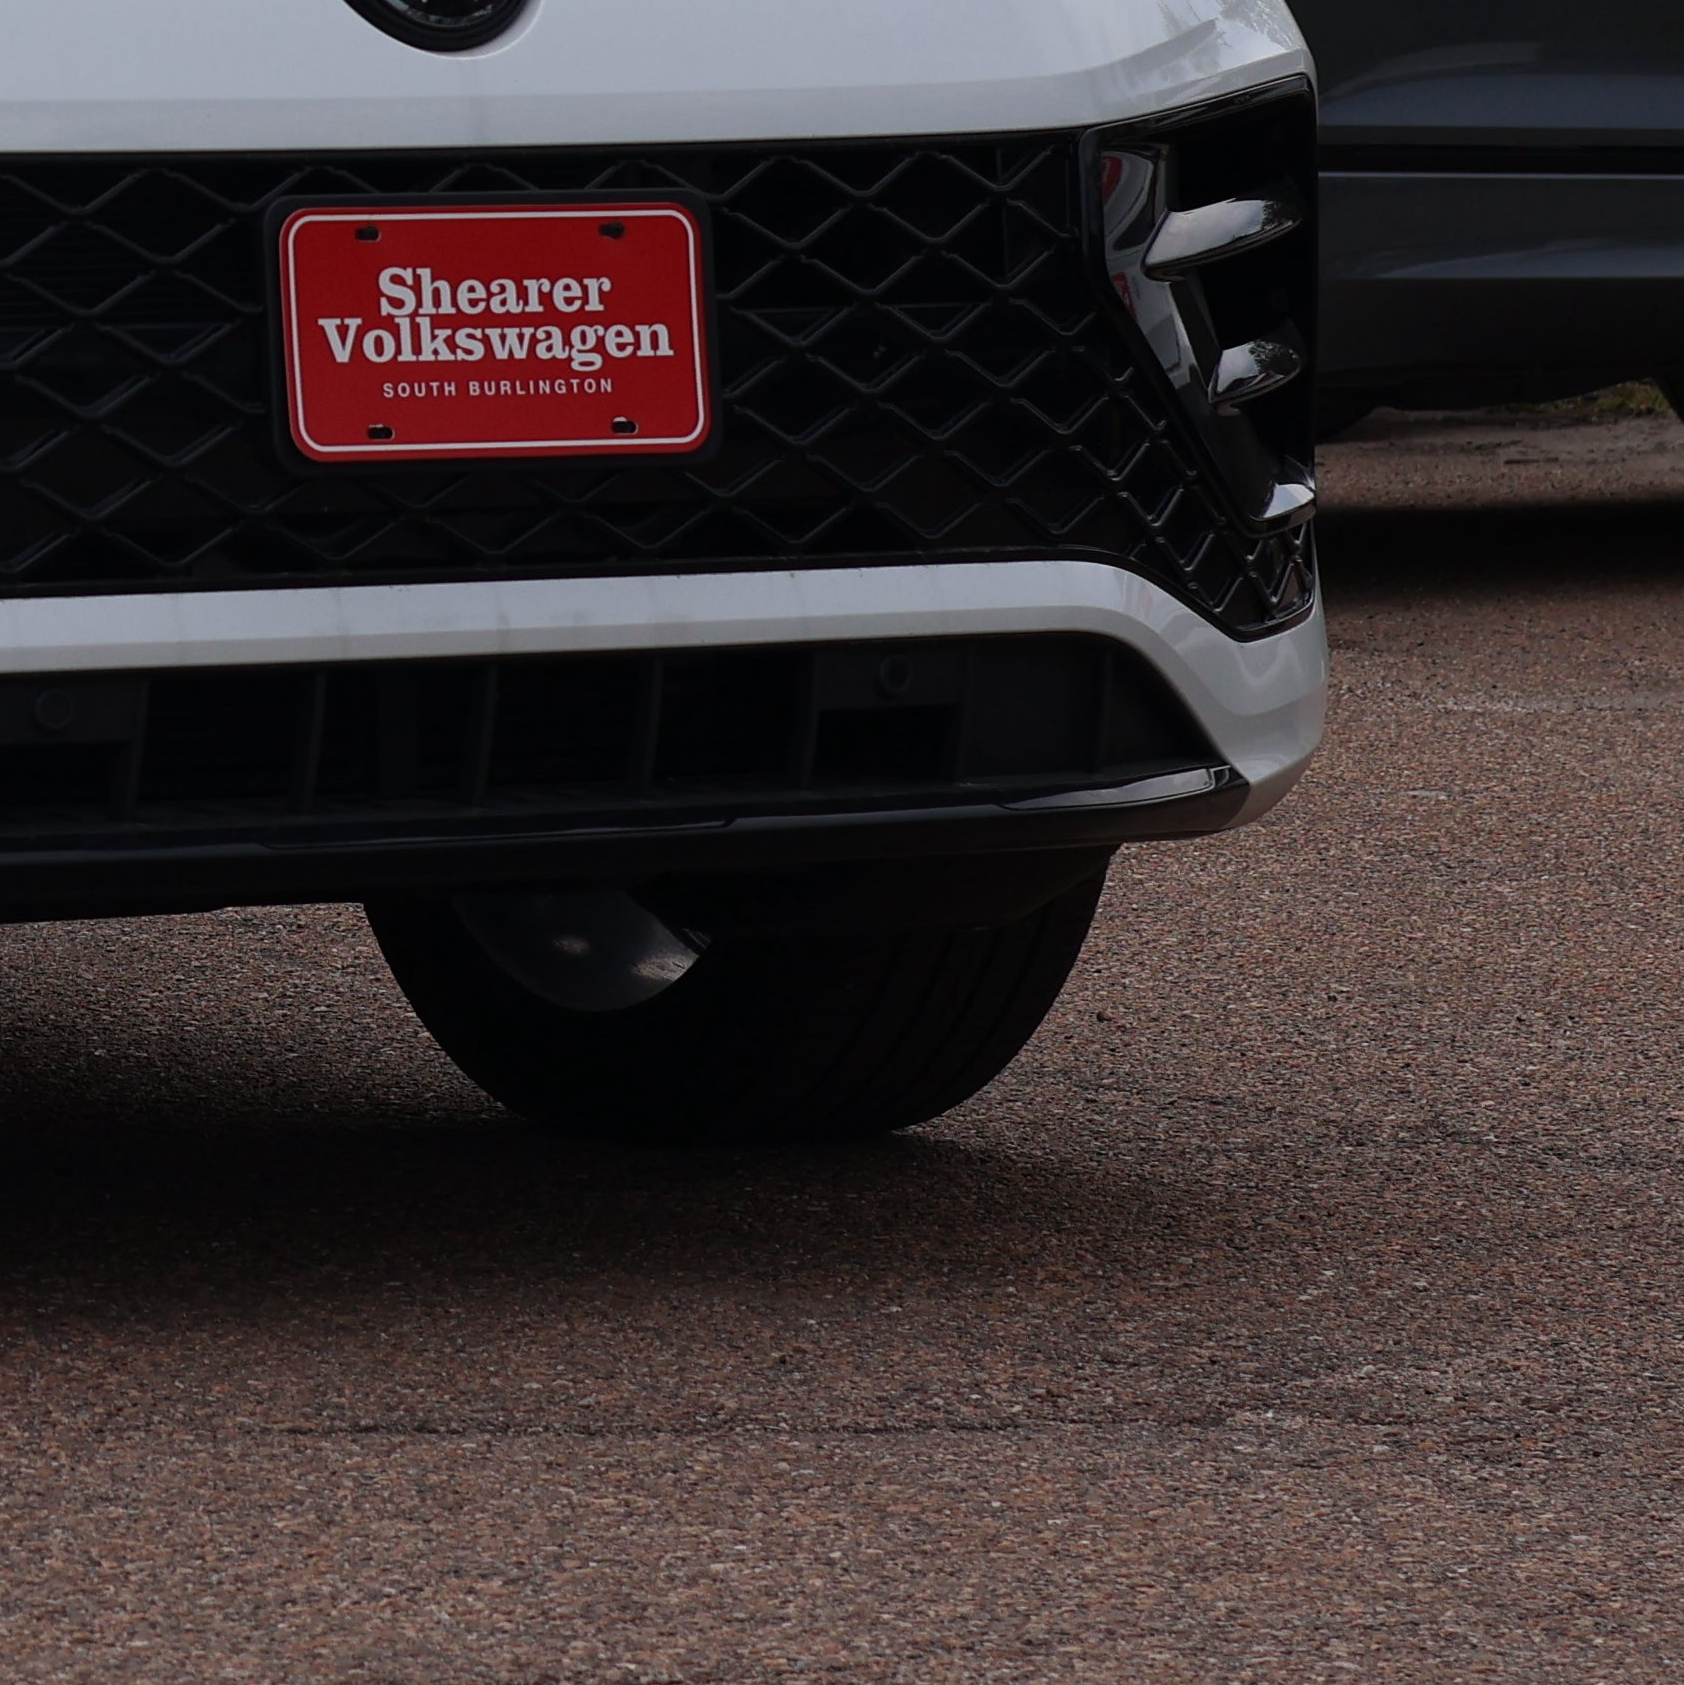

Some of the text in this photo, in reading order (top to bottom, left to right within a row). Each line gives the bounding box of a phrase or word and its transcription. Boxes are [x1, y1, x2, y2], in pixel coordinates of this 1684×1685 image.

[377, 266, 612, 317] Shearer
[317, 316, 675, 372] Volkswagen
[382, 377, 614, 398] SOUTH BURLINGTON
